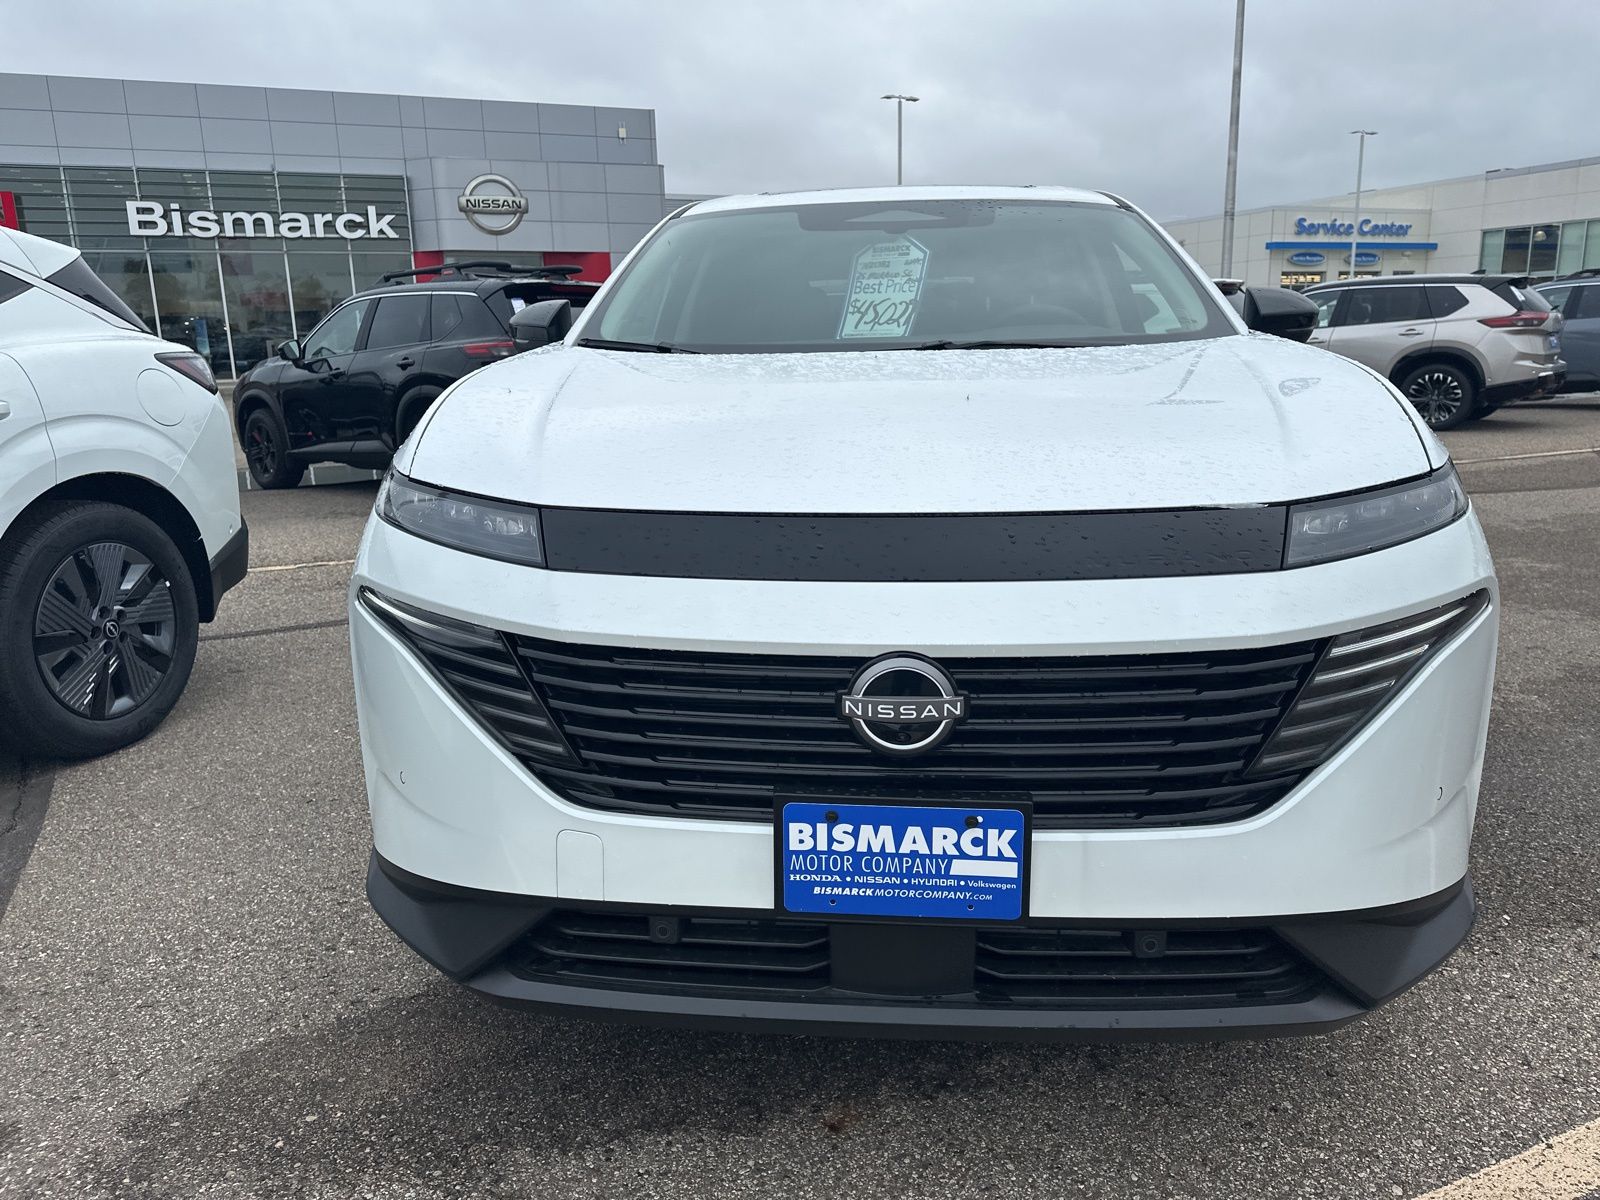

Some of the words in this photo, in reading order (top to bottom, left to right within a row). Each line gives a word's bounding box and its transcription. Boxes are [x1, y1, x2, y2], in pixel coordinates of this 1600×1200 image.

[465, 199, 522, 210] NISSAN
[126, 200, 399, 240] Bismarck
[1295, 217, 1355, 236] Service
[1357, 218, 1413, 237] Center
[853, 280, 883, 295] Best
[884, 279, 916, 294] Price
[845, 700, 961, 719] NISSAN
[788, 822, 1018, 859] BISMARCK
[790, 854, 853, 873] MOTOR
[861, 856, 949, 876] COMPANY
[789, 873, 842, 882] HONDA
[854, 875, 900, 885] NISSAN
[911, 877, 957, 887] HYUNDAI
[967, 879, 1017, 889] Volkswagen
[813, 886, 993, 901] BISMARCKMOTORCOMPANY.COM
